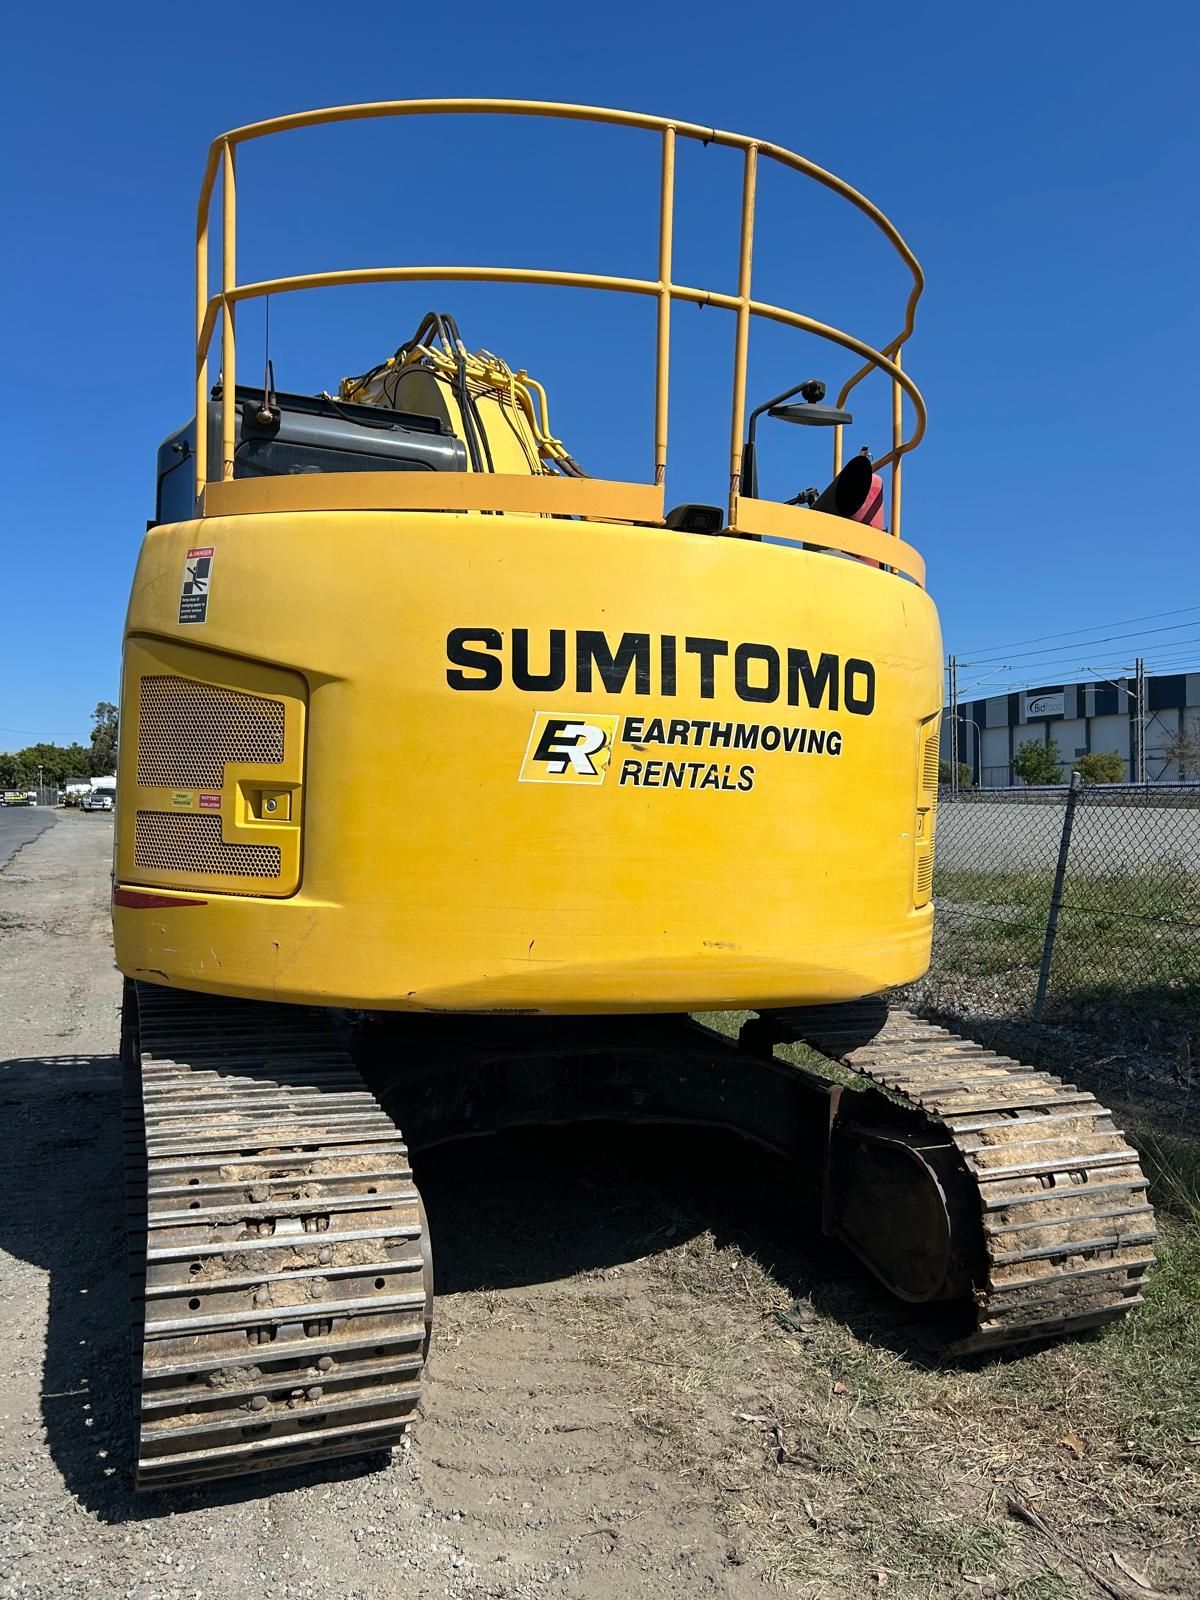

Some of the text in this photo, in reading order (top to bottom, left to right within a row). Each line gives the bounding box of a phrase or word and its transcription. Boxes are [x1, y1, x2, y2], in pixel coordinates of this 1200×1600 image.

[446, 628, 876, 716] SUMITOMO
[621, 716, 843, 756] EARTHMOVING
[619, 759, 756, 791] RENTALS
